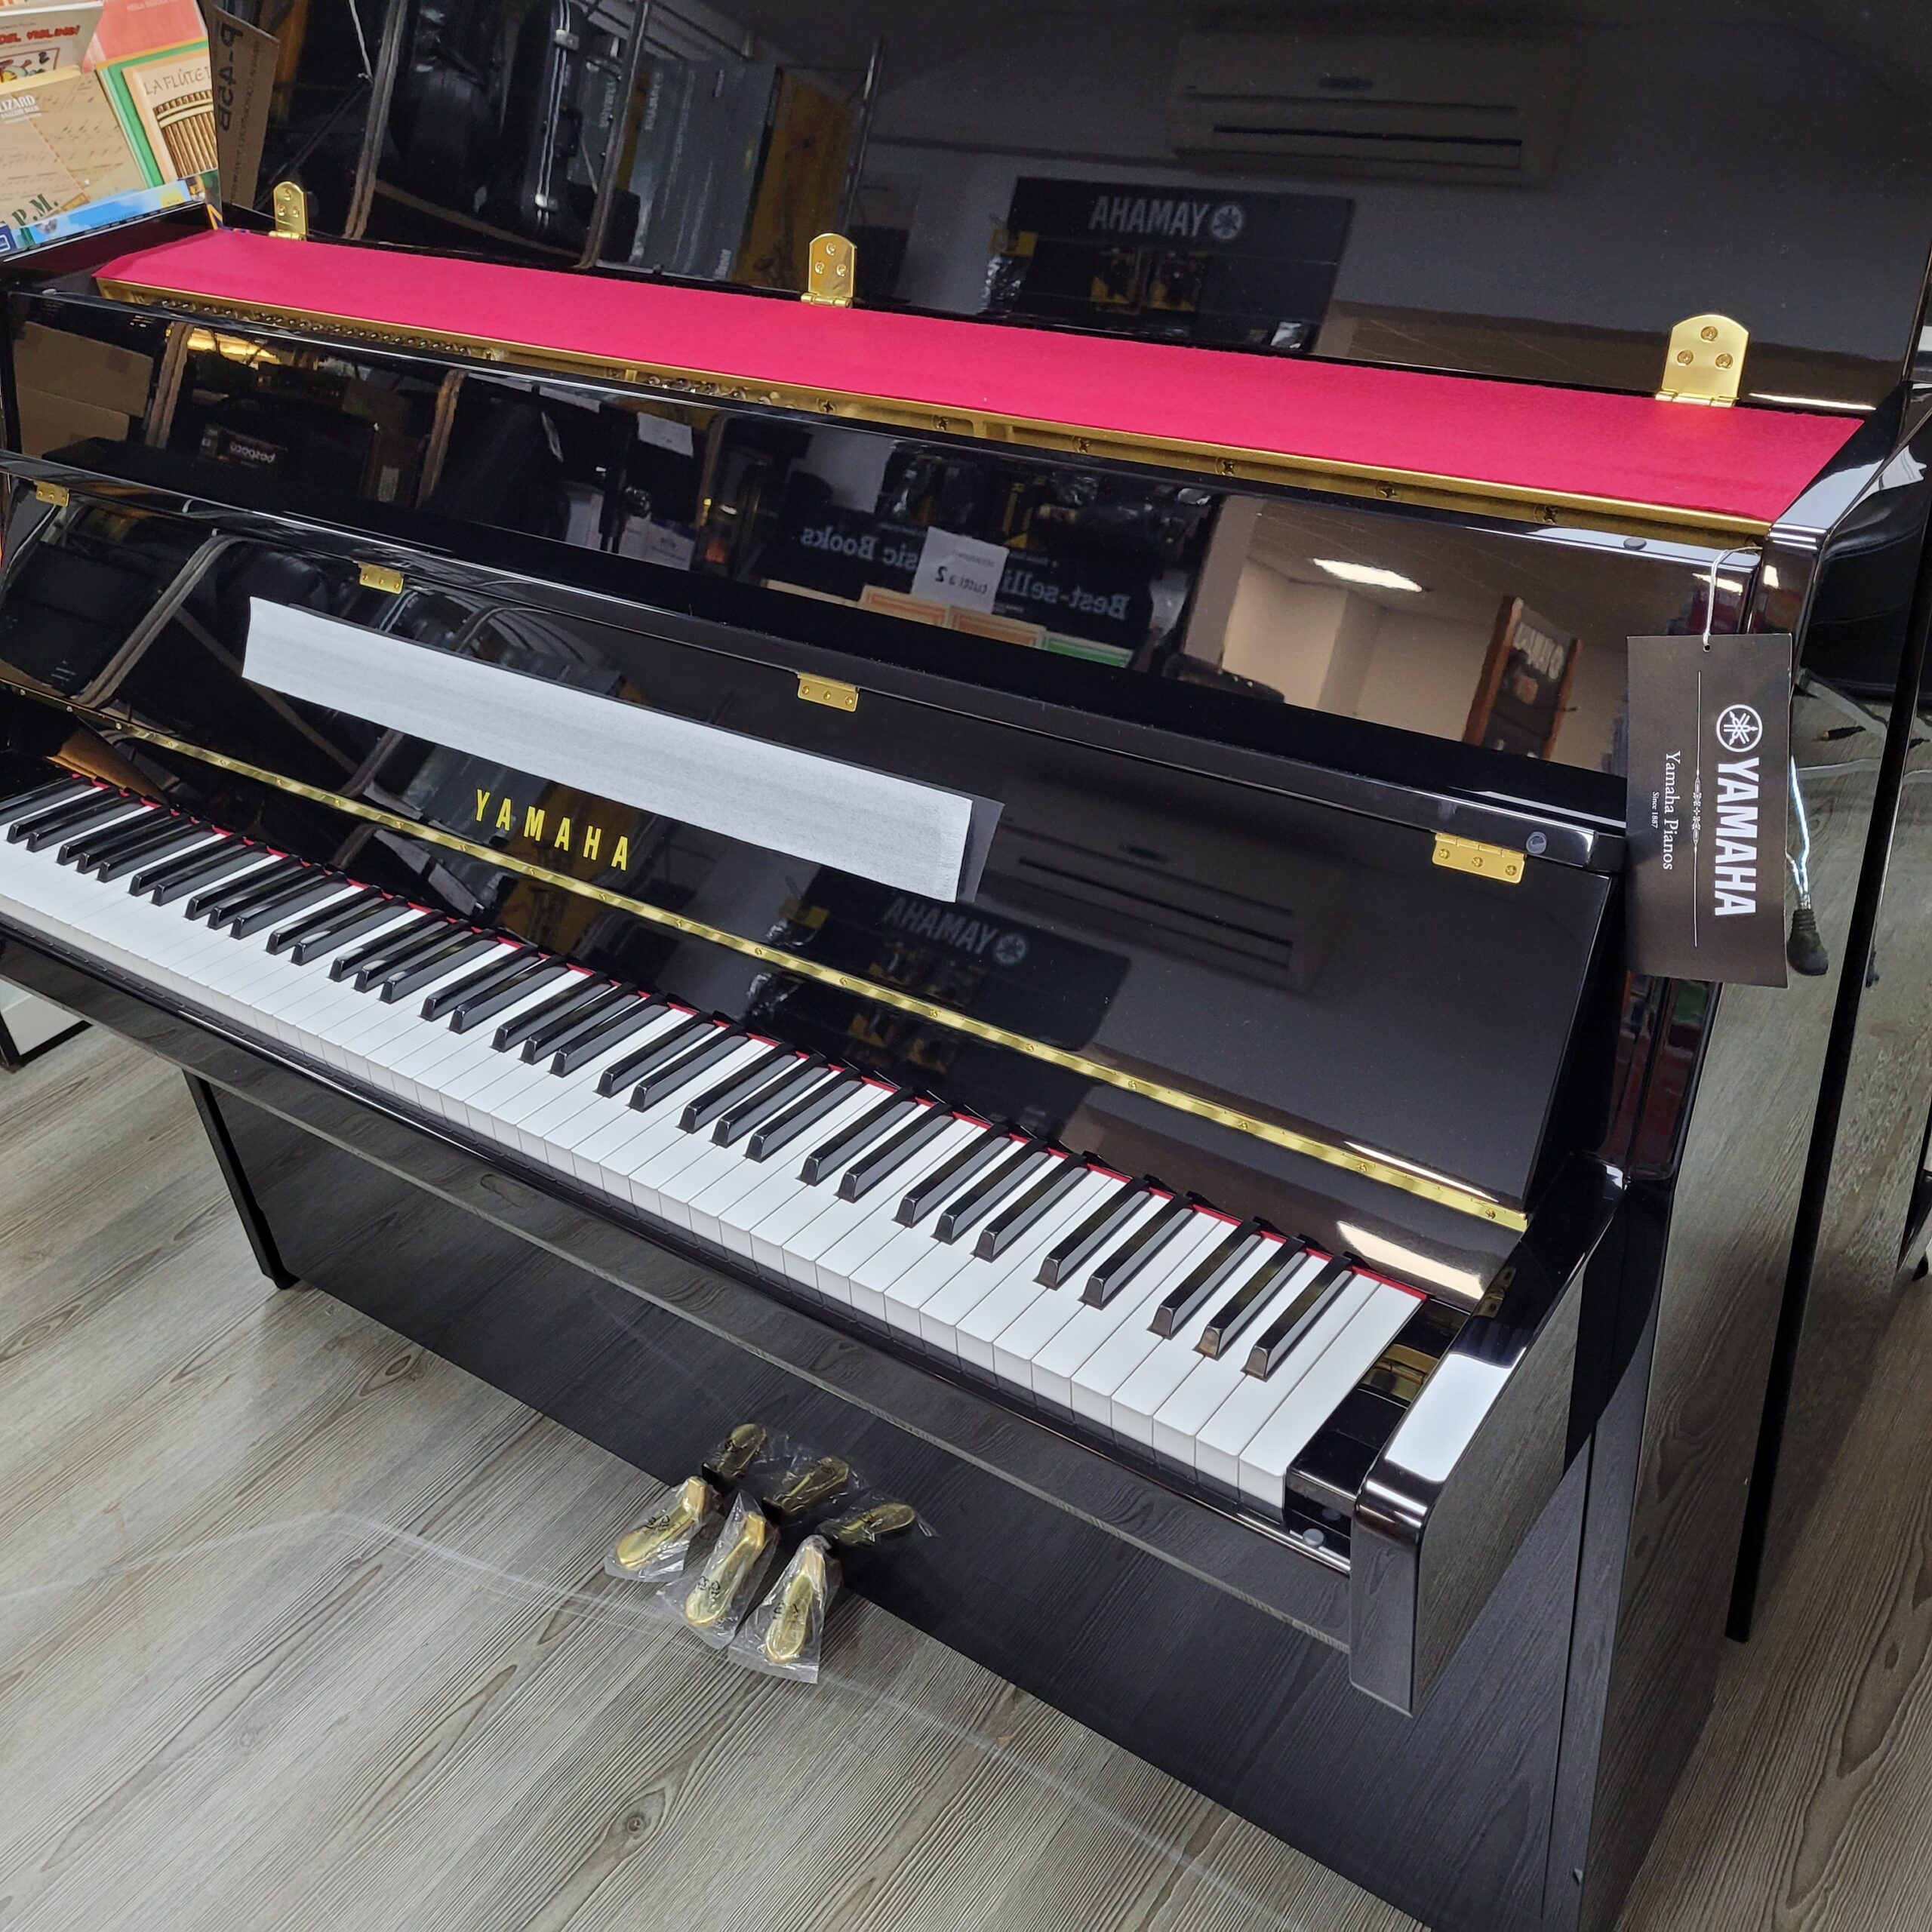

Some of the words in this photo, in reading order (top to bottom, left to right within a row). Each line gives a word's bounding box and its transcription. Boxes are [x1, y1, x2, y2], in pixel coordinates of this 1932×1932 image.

[143, 79, 164, 95] LA
[1651, 791, 1660, 811] Since
[1663, 750, 1681, 814] Yamaha
[475, 789, 629, 872] YAMAHA
[1651, 811, 1659, 830] 1887
[1663, 819, 1679, 871] Pianos
[1714, 757, 1760, 916] YAMAHA
